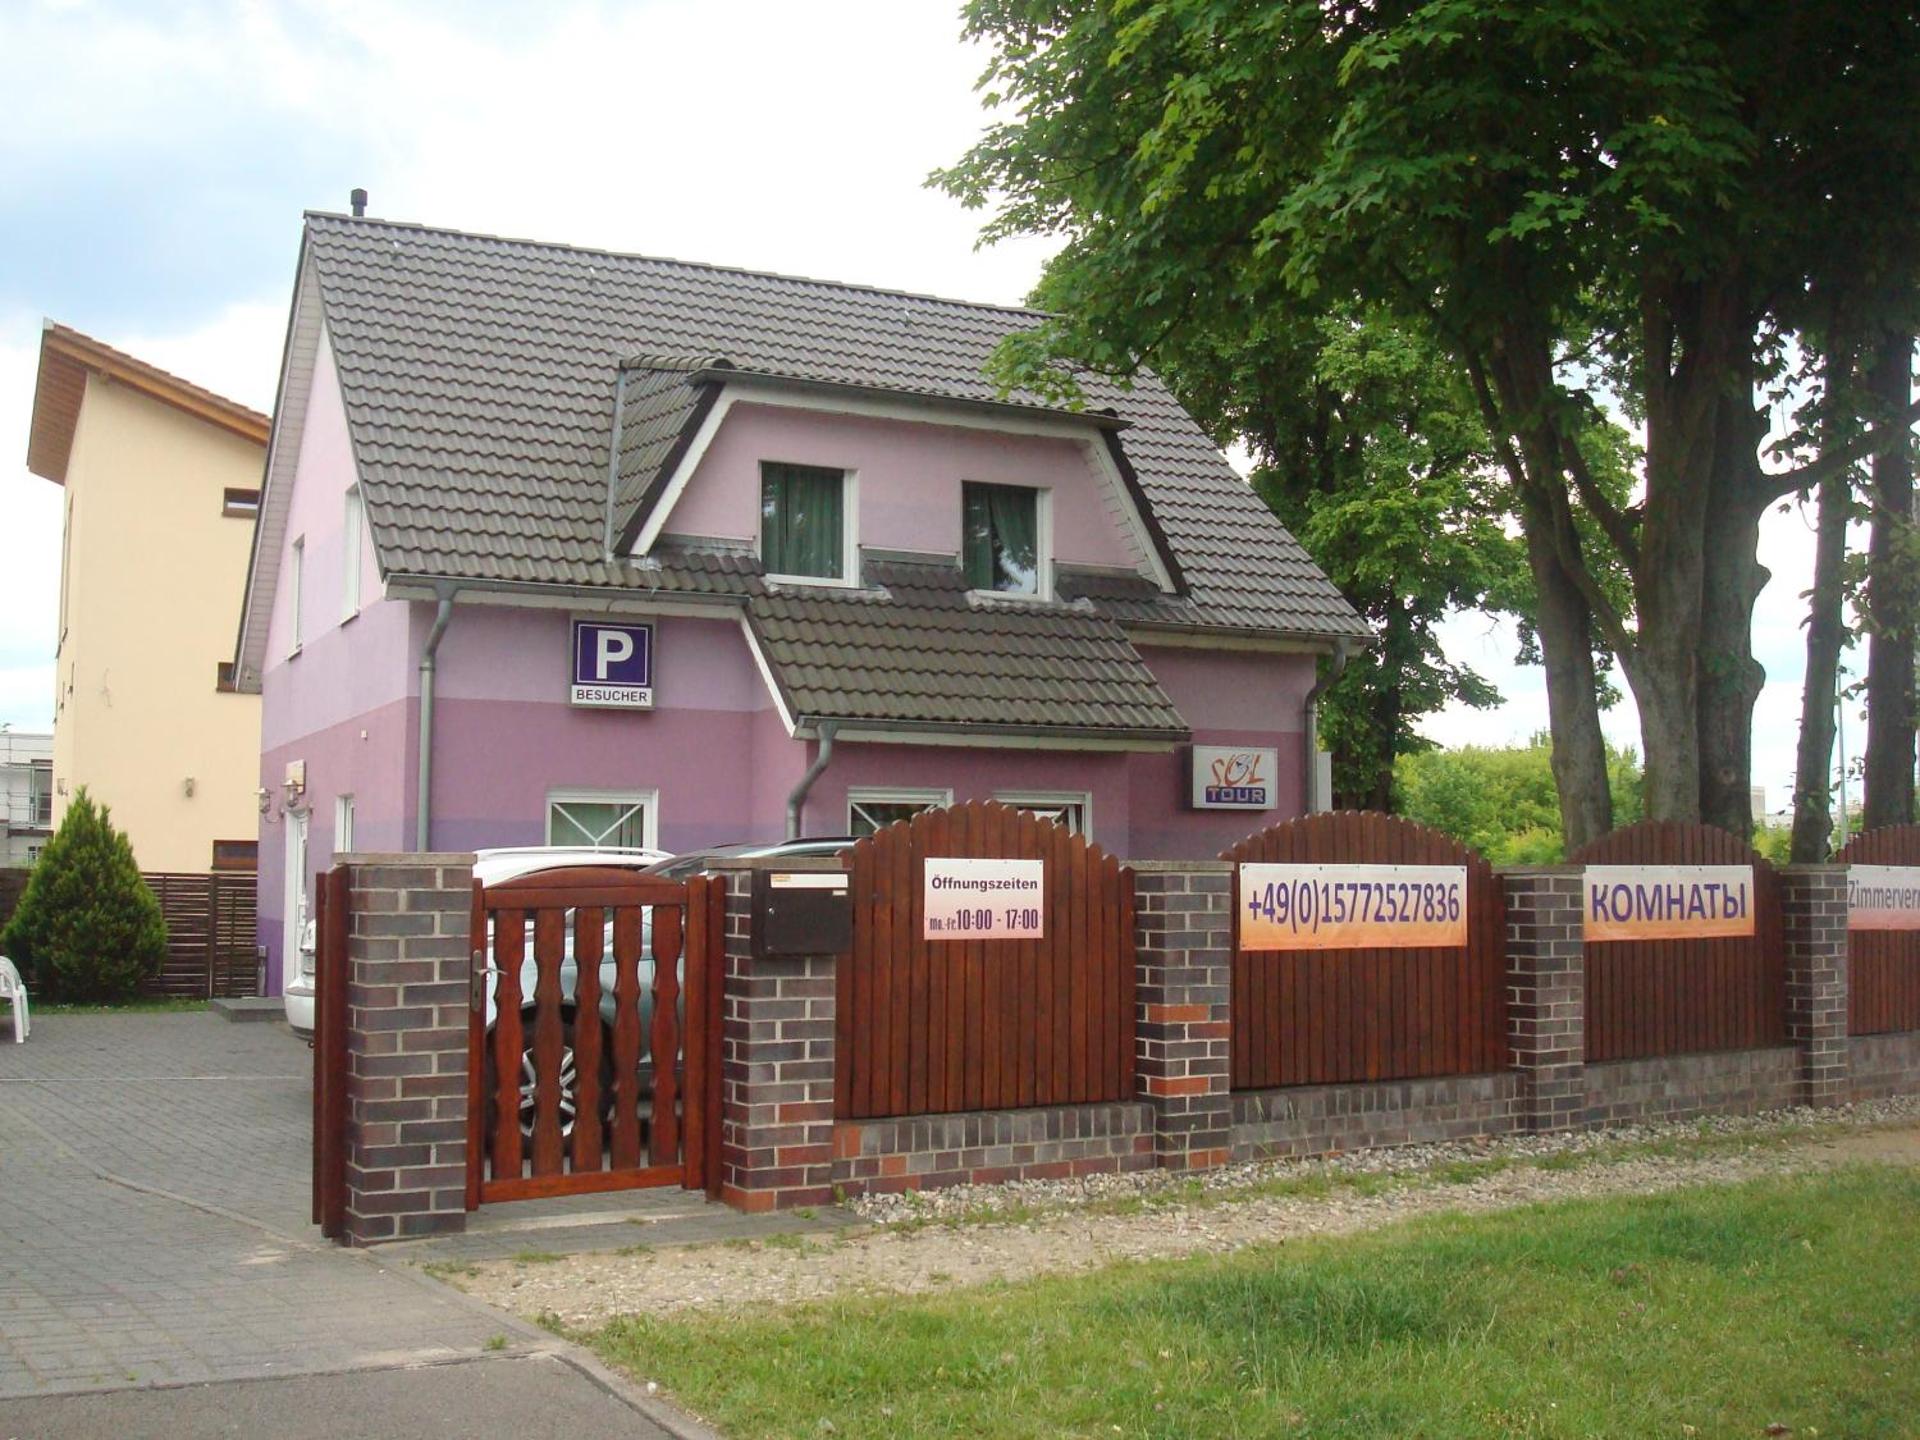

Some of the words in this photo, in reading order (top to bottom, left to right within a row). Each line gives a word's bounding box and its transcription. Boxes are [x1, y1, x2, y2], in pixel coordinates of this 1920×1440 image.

[596, 629, 634, 680] P
[576, 689, 648, 702] BESUCHER
[1211, 753, 1265, 787] SOL
[1207, 787, 1264, 803] TOUR
[931, 874, 1038, 893] Öffnungszeiten
[1848, 879, 1920, 909] Zimmerver
[1248, 879, 1461, 934] +49(0)15772527836
[1591, 883, 1746, 923] КОМНАТЫ
[1005, 909, 1038, 930] 17:00
